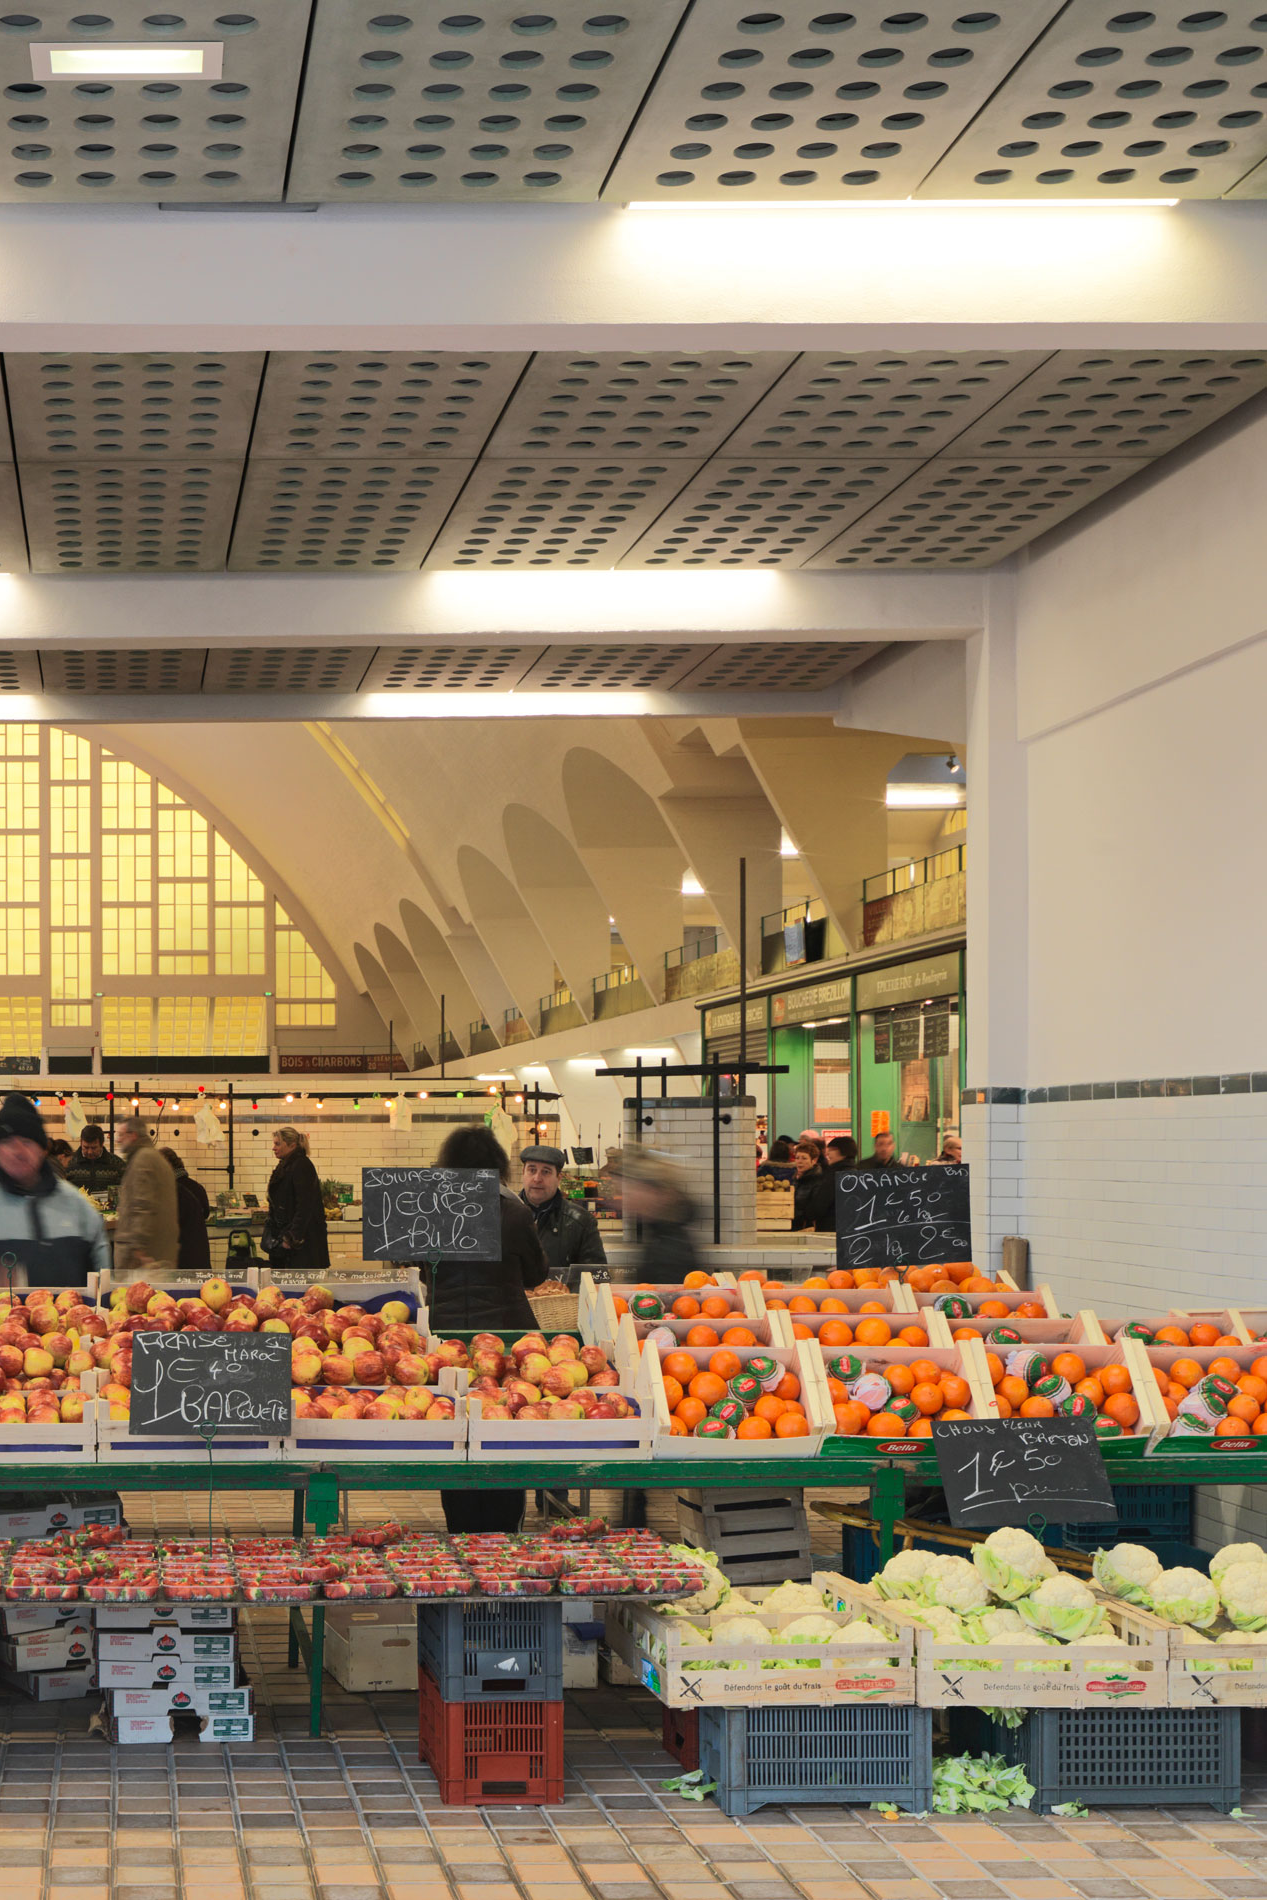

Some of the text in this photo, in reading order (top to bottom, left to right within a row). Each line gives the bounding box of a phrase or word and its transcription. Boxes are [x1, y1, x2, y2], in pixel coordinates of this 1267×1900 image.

[788, 988, 818, 1010] BOUCHERIE
[281, 1057, 303, 1067] BOIS
[312, 1056, 362, 1067] CHARBONS
[225, 1349, 282, 1362] MAROC
[1064, 1683, 1080, 1691] frais
